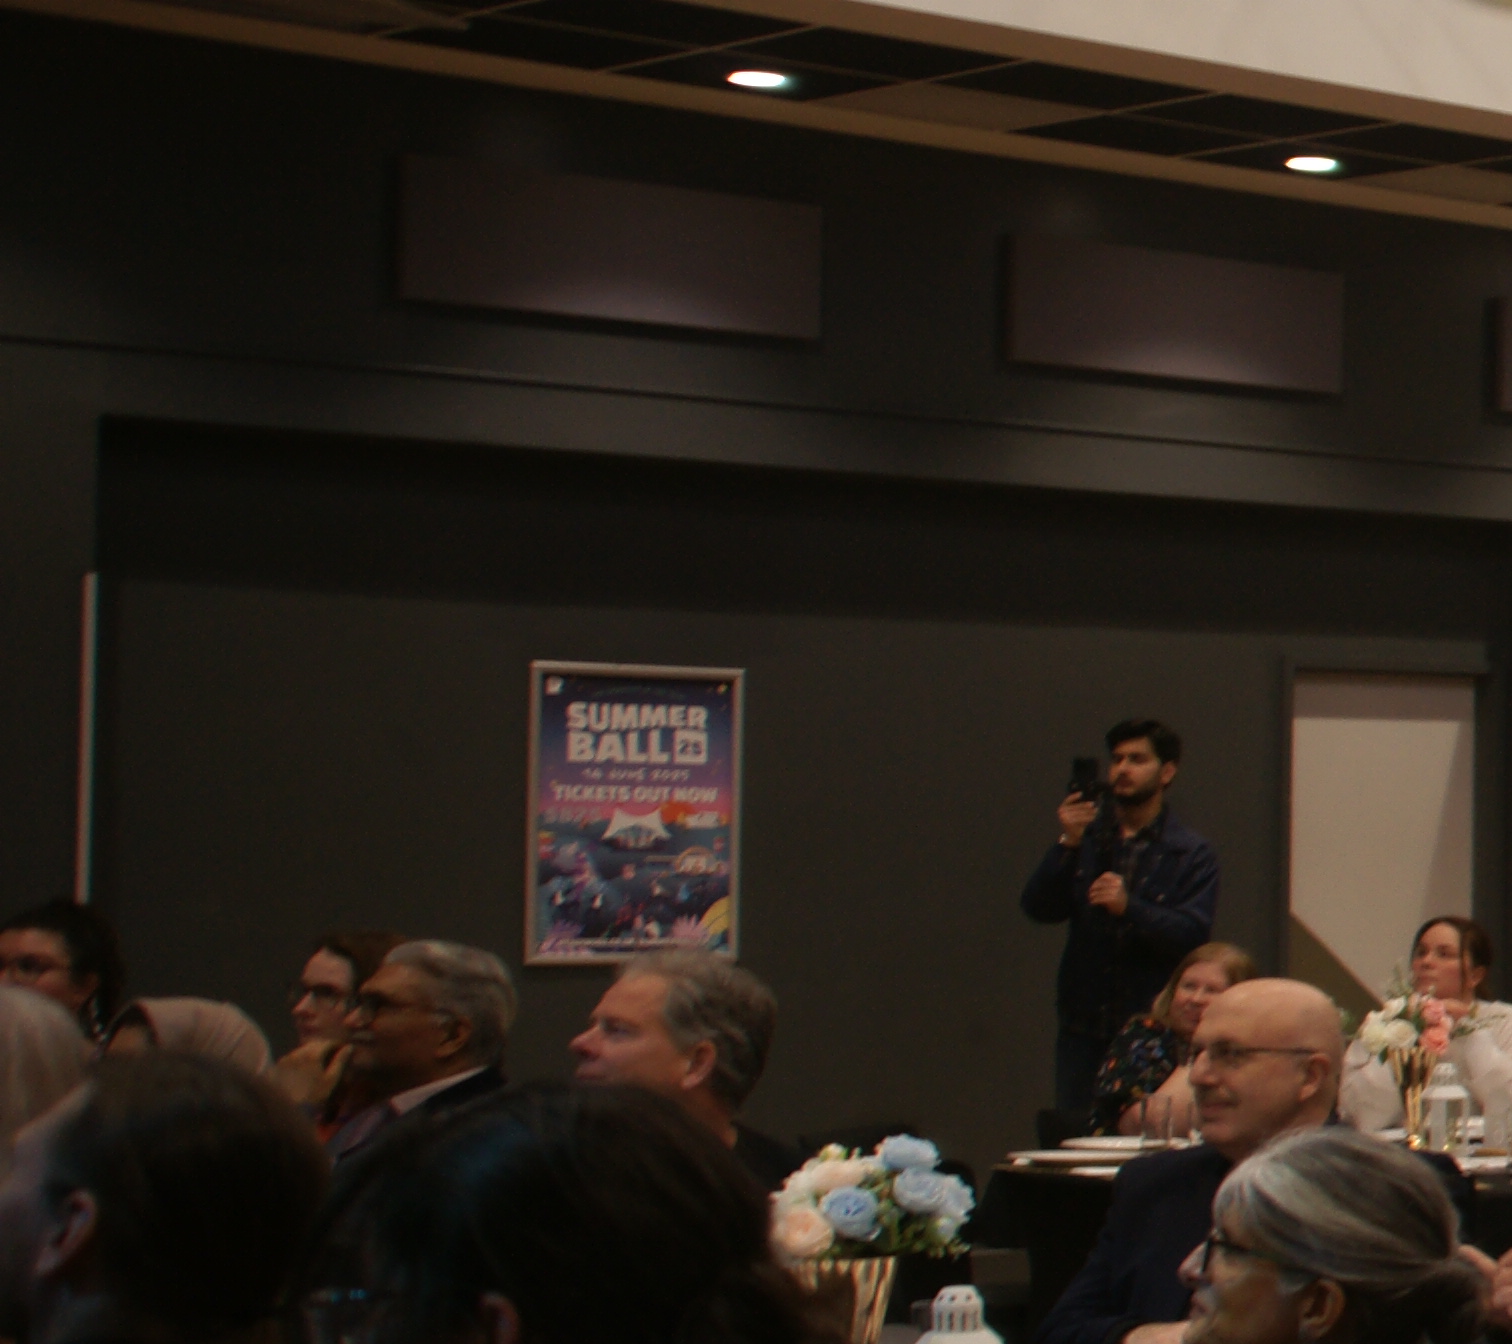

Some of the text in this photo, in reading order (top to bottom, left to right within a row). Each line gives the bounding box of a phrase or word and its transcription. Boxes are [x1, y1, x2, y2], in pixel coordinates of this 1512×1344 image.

[565, 700, 708, 730] SUMMER
[565, 728, 672, 764] BALL
[554, 783, 719, 803] TICKETS OUT NOW
